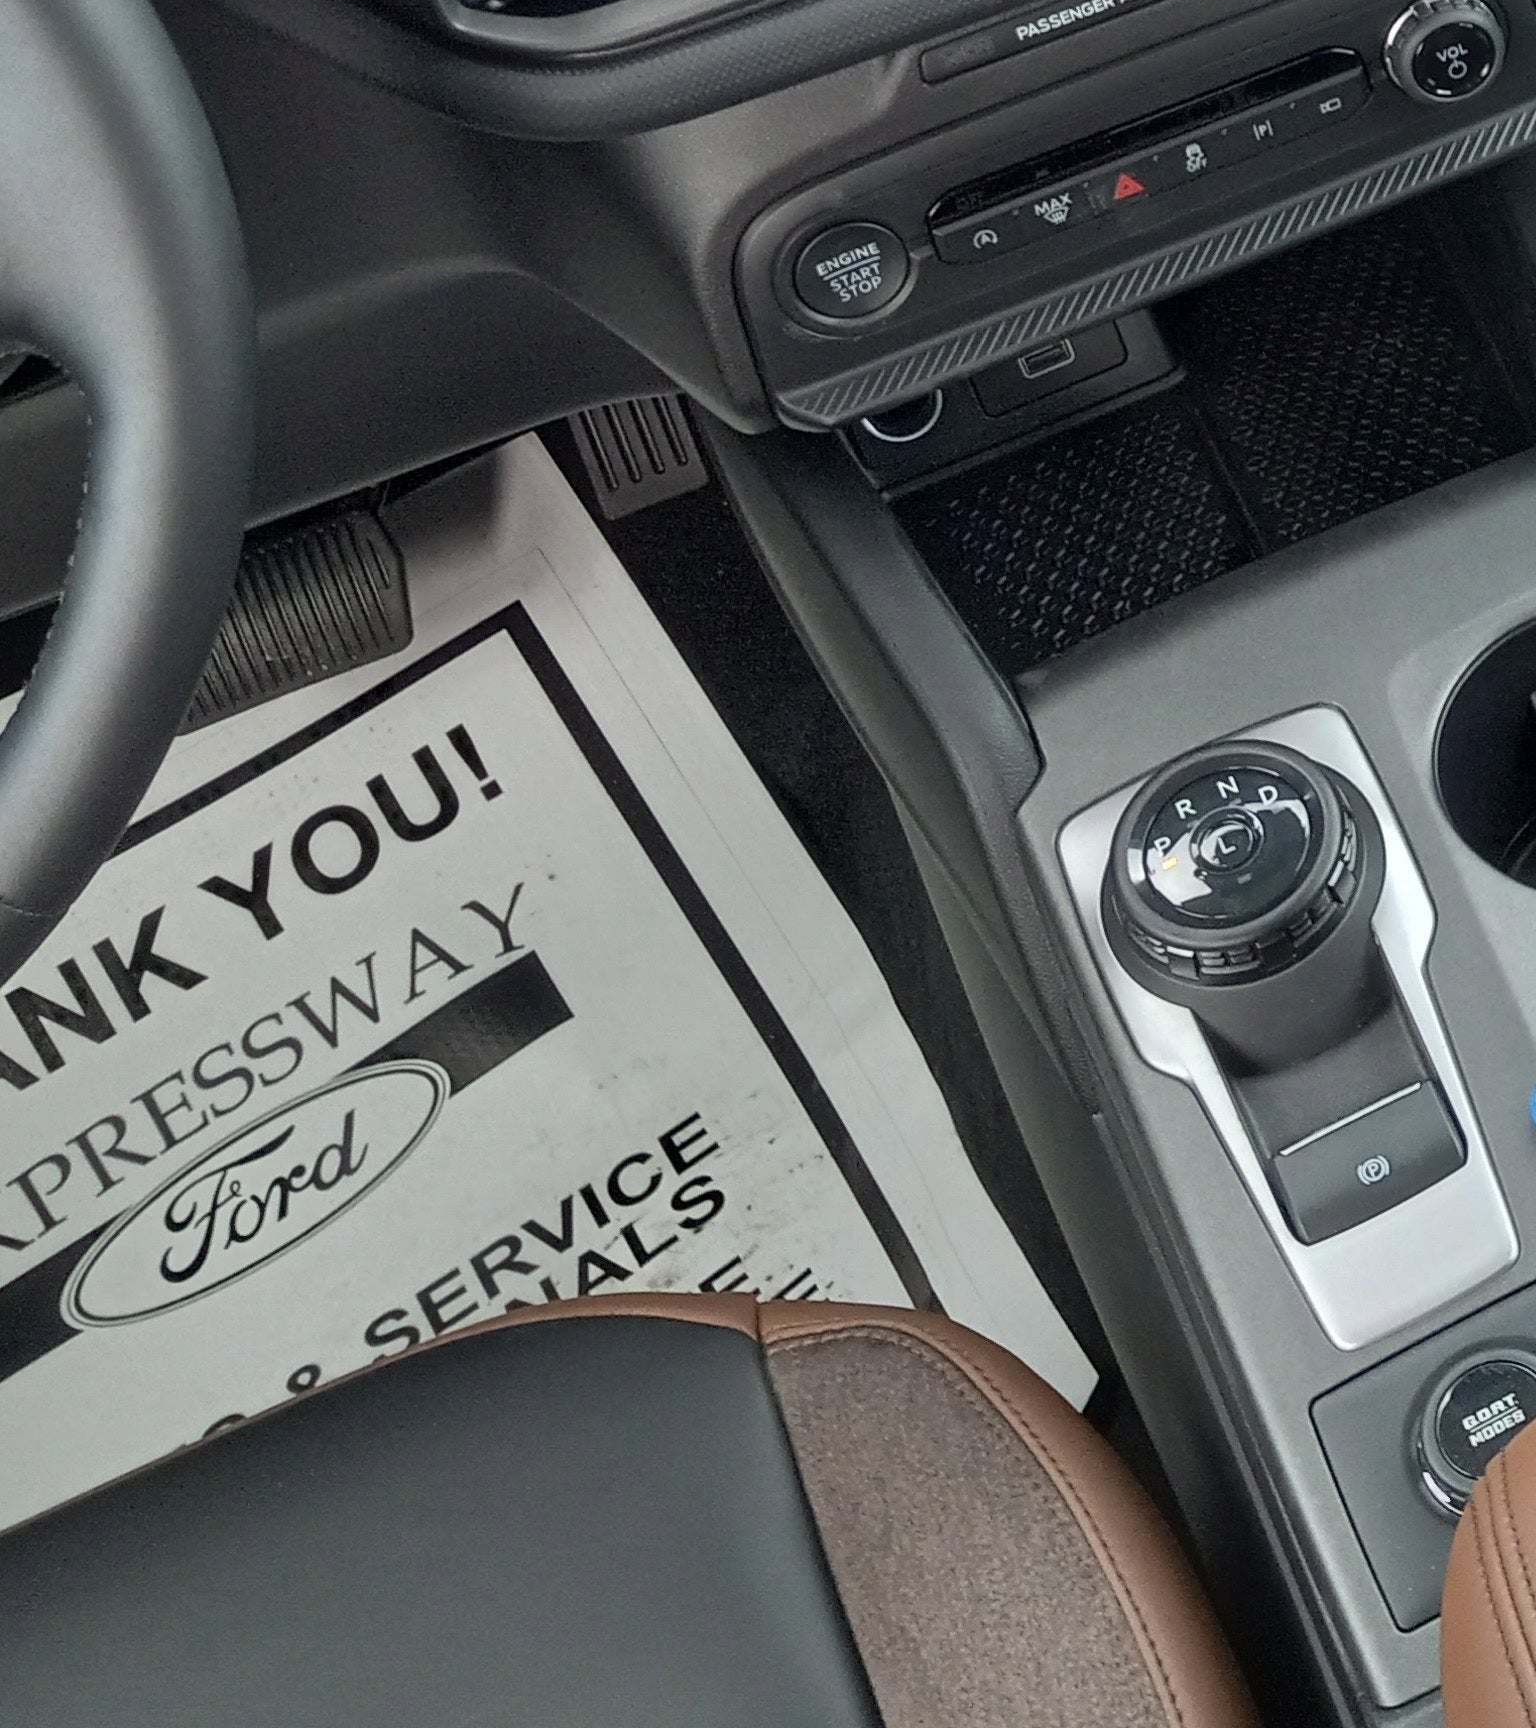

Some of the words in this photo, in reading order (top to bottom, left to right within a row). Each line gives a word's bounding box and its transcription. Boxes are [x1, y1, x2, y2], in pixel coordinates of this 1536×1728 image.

[1435, 42, 1469, 62] VOL
[1034, 192, 1073, 216] MAX
[815, 242, 880, 276] ENGINE
[829, 262, 880, 292] START
[839, 275, 881, 303] STOP
[1176, 799, 1197, 819] R
[1217, 776, 1240, 797] N
[1258, 785, 1279, 805] D
[199, 724, 504, 941] YOU!
[1217, 836, 1236, 856] L
[160, 1110, 369, 1283] Ford
[364, 1112, 721, 1364] SERVICE
[1468, 1409, 1526, 1448] MODES
